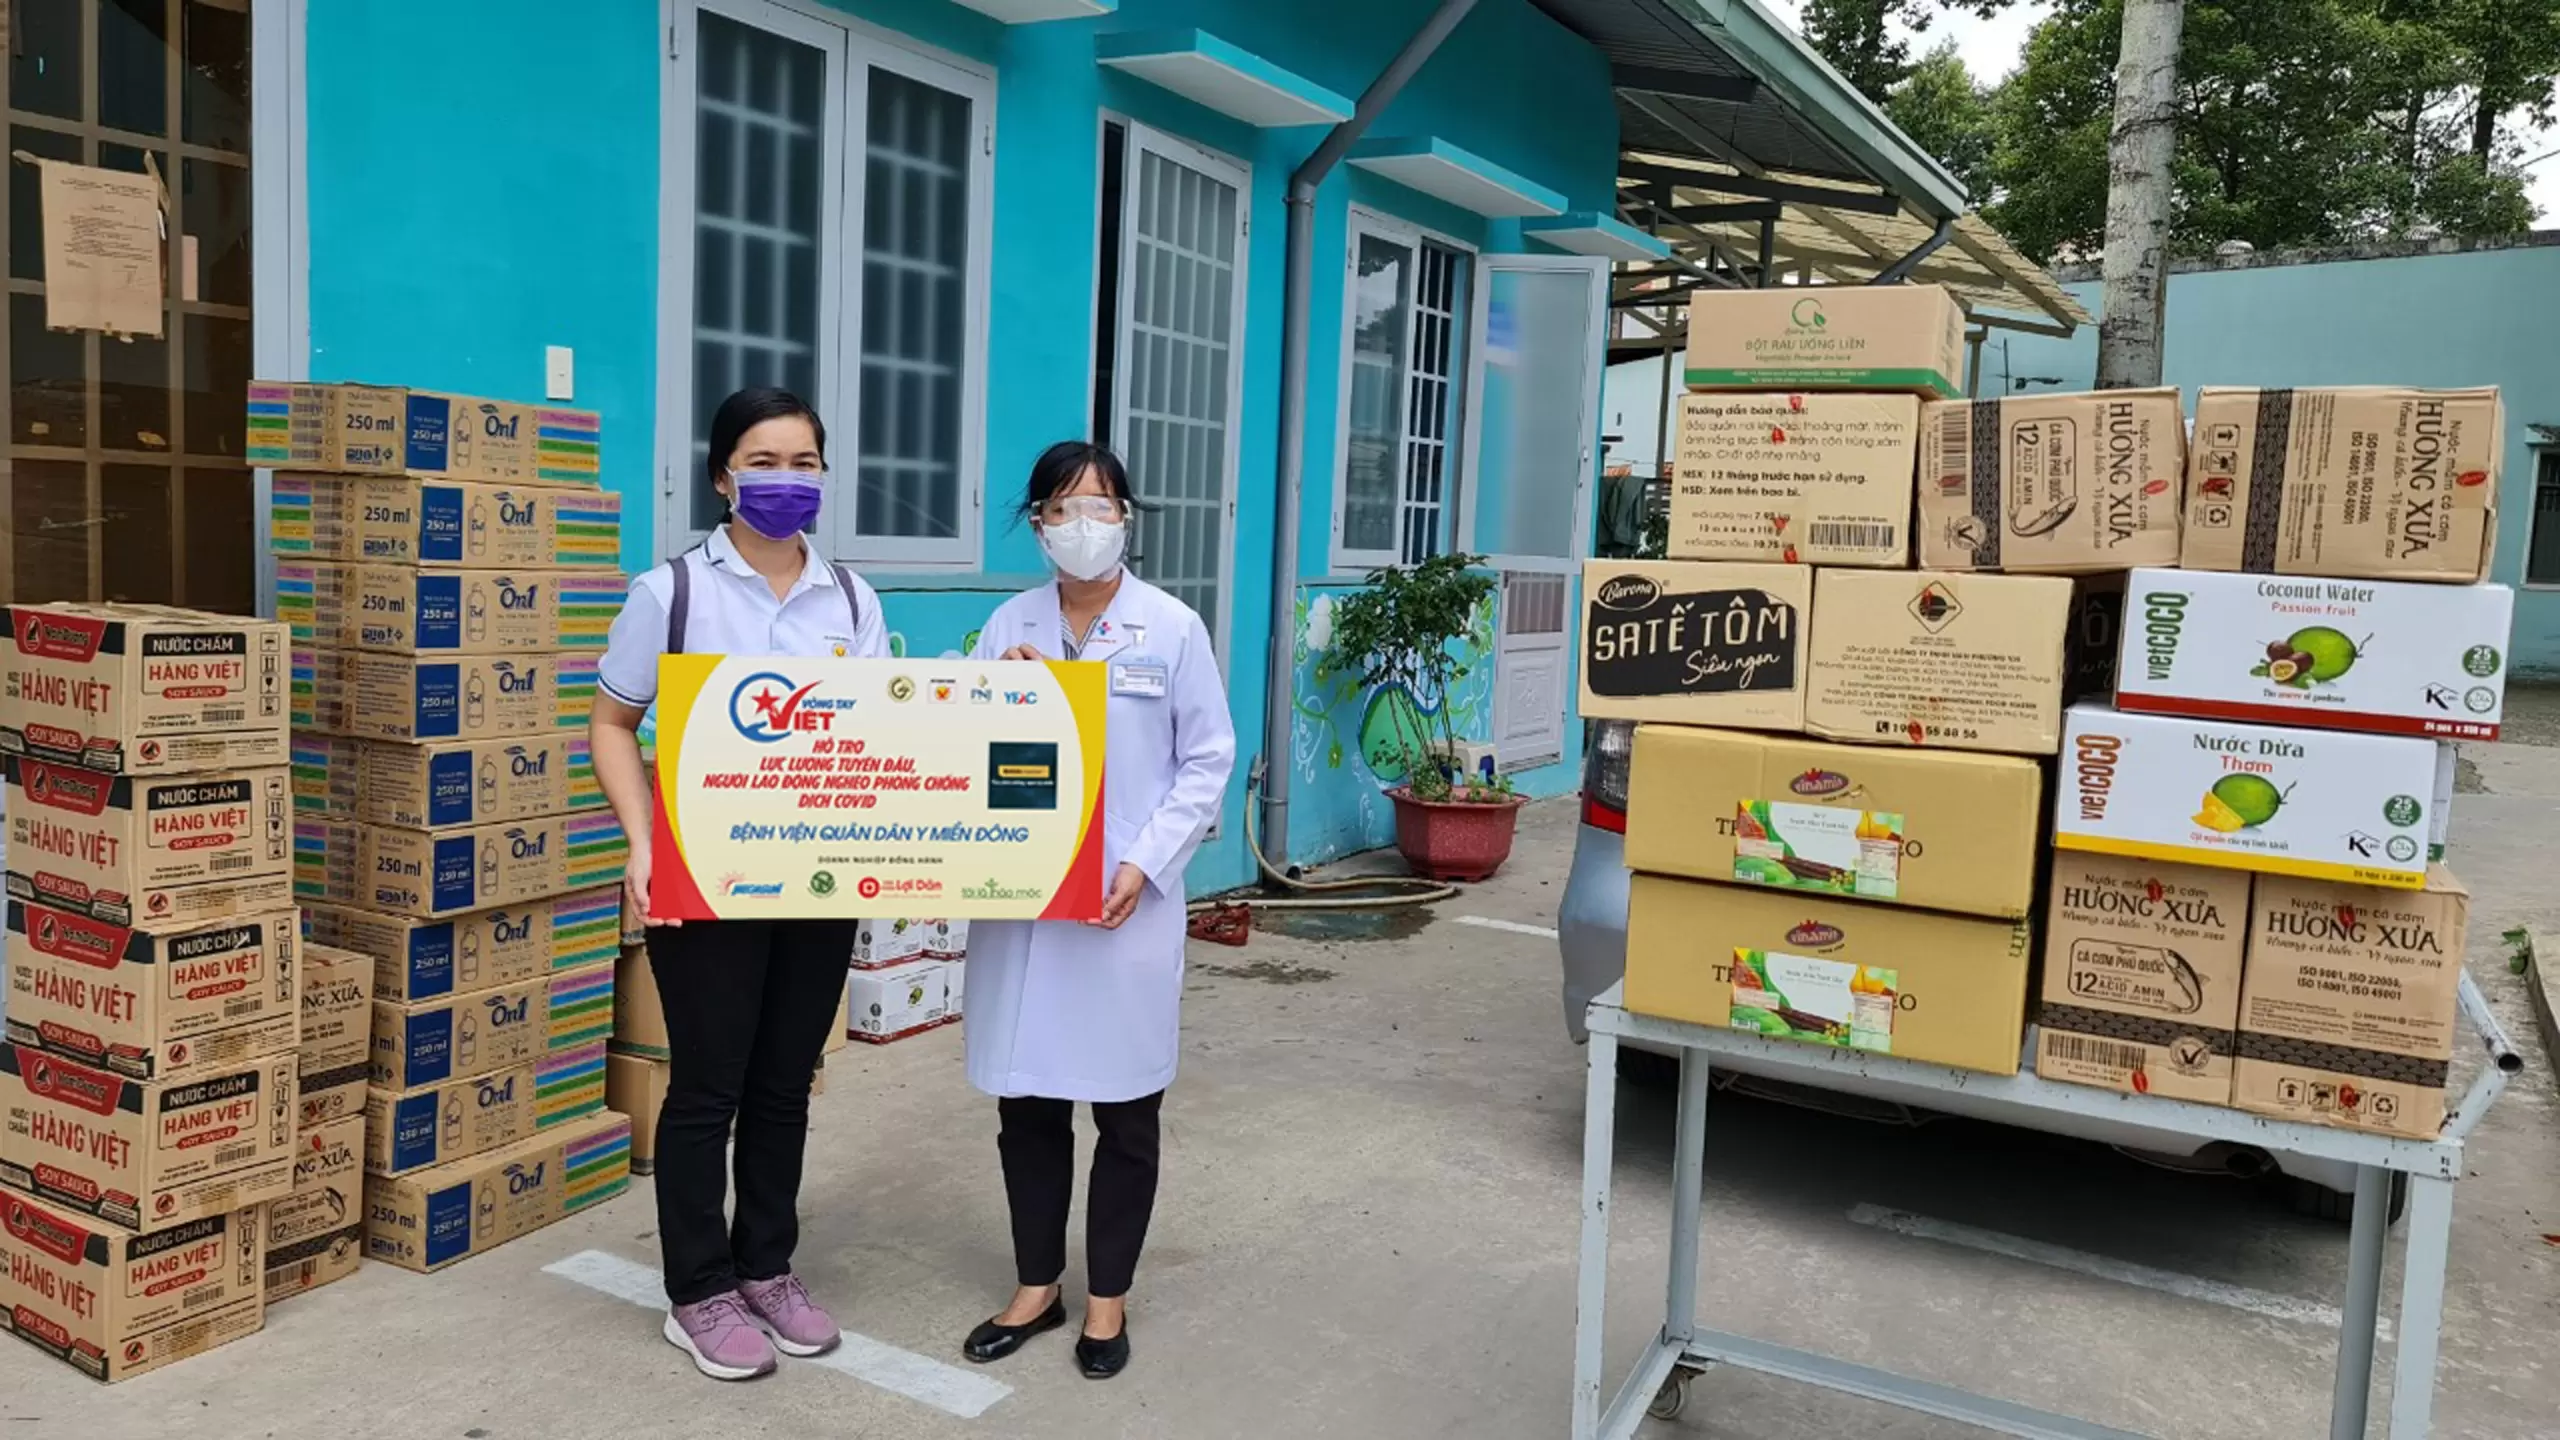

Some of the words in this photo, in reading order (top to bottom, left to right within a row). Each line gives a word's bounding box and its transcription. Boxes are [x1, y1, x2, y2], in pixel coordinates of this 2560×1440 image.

[346, 414, 373, 430] 250
[376, 415, 395, 431] ml
[2016, 424, 2039, 446] 12
[2109, 402, 2139, 485] HƯƠNG
[2409, 399, 2446, 491] HƯƠNG
[1709, 485, 1733, 496] Xem
[364, 506, 393, 523] 250
[395, 507, 411, 523] ml
[2108, 493, 2138, 549] XƯA
[2401, 499, 2438, 560] XƯA
[361, 594, 388, 611] 250
[390, 596, 406, 612] ml
[2257, 581, 2321, 600] Coconut
[2326, 583, 2375, 603] Water
[1701, 595, 1787, 648] TÔM
[2271, 602, 2322, 614] Passion
[2326, 603, 2357, 617] fruit
[153, 637, 191, 653] NƯỚC
[193, 636, 233, 651] CHẤM
[149, 662, 198, 681] HÀNG
[203, 658, 241, 680] VIỆT
[1681, 649, 1733, 685] Siêu
[1735, 652, 1780, 689] ngon
[21, 668, 66, 706] HÀNG
[70, 676, 111, 717] VIỆT
[29, 726, 49, 740] SOY
[50, 728, 78, 747] SAUCE
[2193, 733, 2251, 754] Nước
[2259, 738, 2305, 758] Dừa
[2221, 755, 2273, 773] Thơm
[158, 788, 196, 804] NƯỚC
[199, 784, 239, 800] CHẤM
[751, 774, 780, 789] LAO
[834, 793, 877, 809] COVID
[154, 812, 205, 833] HÀNG
[209, 809, 247, 830] VIỆT
[730, 821, 776, 844] BỆNH
[779, 820, 817, 844] VIỆN
[820, 822, 872, 842] QUÂN
[874, 823, 913, 841] DÂN
[916, 826, 928, 841] Y
[975, 823, 1029, 843] ĐÔNG
[30, 816, 74, 857] HÀNG
[79, 831, 119, 870] VIỆT
[377, 856, 400, 873] 250
[403, 858, 421, 877] ml
[38, 875, 58, 890] SOY
[59, 878, 87, 898] SAUCE
[2064, 886, 2154, 917] HƯƠNG
[2163, 898, 2226, 928] XƯA
[177, 939, 213, 956] NƯỚC
[215, 931, 250, 950] CHẤM
[2267, 910, 2367, 943] HƯƠNG
[2375, 923, 2443, 955] XƯA
[175, 960, 221, 985] HÀNG
[225, 953, 259, 976] VIỆT
[2074, 971, 2098, 993] 12
[2133, 984, 2165, 999] AMIN
[35, 967, 85, 1010] HÀNG
[91, 983, 136, 1024] VIỆT
[43, 1024, 64, 1041] SOY
[65, 1029, 98, 1051] SAUCE
[169, 1090, 206, 1107] NƯỚC
[208, 1078, 246, 1099] CHẤM
[164, 1112, 211, 1135] HÀNG
[216, 1100, 253, 1123] VIỆT
[32, 1109, 86, 1153] HÀNG
[89, 1128, 131, 1171] VIỆT
[38, 1167, 60, 1184] SOY
[59, 1172, 94, 1197] SAUCE
[372, 1205, 396, 1224] 250
[398, 1213, 417, 1229] ml
[131, 1252, 179, 1284] HÀNG
[184, 1240, 220, 1265] VIỆT
[12, 1251, 56, 1300] HÀNG
[58, 1275, 96, 1320] VIỆT
[17, 1309, 36, 1329] SOY
[37, 1316, 66, 1344] SAUCE
